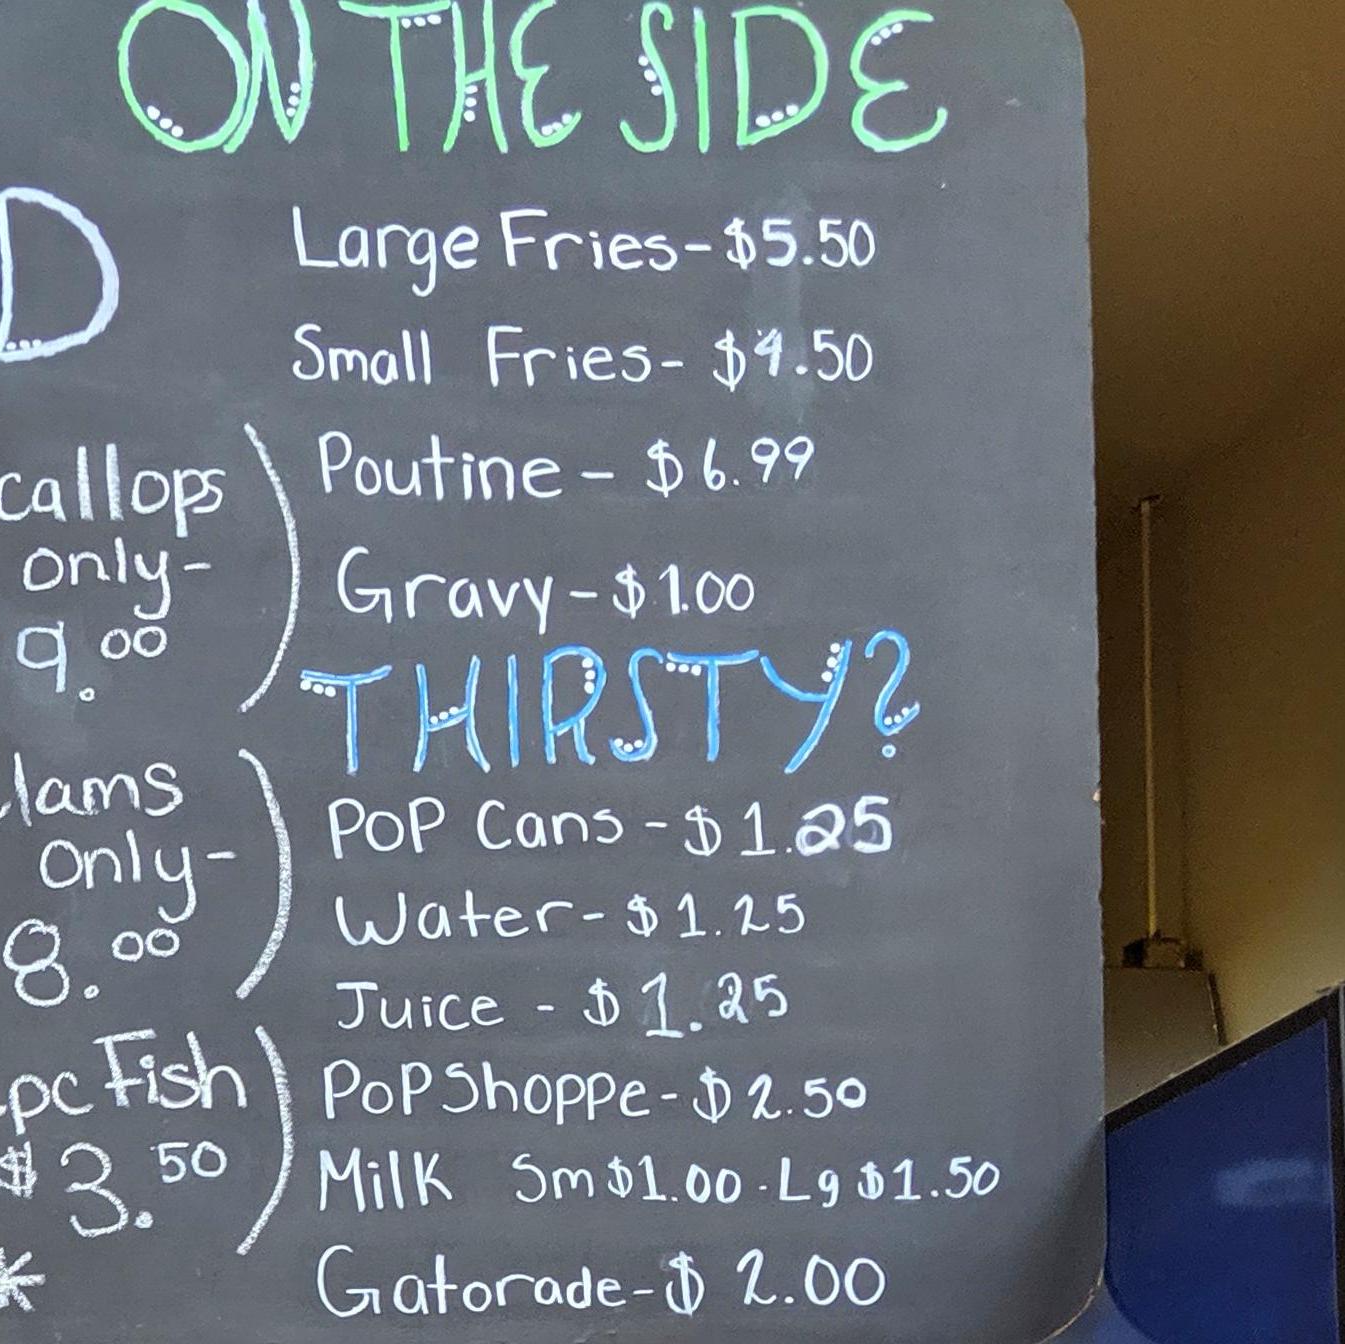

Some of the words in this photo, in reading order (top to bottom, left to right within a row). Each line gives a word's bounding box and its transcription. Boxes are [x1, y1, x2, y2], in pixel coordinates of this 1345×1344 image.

[118, 0, 316, 153] ON
[338, 0, 581, 153] THE
[620, 1, 948, 153] SIDE
[293, 206, 479, 297] Large
[724, 217, 875, 269] $5.50
[293, 323, 431, 385] Small
[713, 328, 872, 392] $4.50
[319, 431, 562, 500] Poutine
[647, 436, 814, 498] $6.99
[613, 563, 754, 619] $1.00
[300, 630, 920, 774] THIRSTY?
[477, 800, 623, 849] Cans
[685, 795, 892, 856] $1.25
[627, 893, 804, 938] $1.25
[336, 982, 504, 1030] Juice
[584, 972, 787, 1038] $1.25
[94, 1028, 248, 1110] Fish
[693, 1066, 866, 1123] $2.50
[608, 1155, 741, 1203] $1.00
[858, 1156, 1000, 1200] $1.50
[666, 1249, 885, 1316] $2.00
